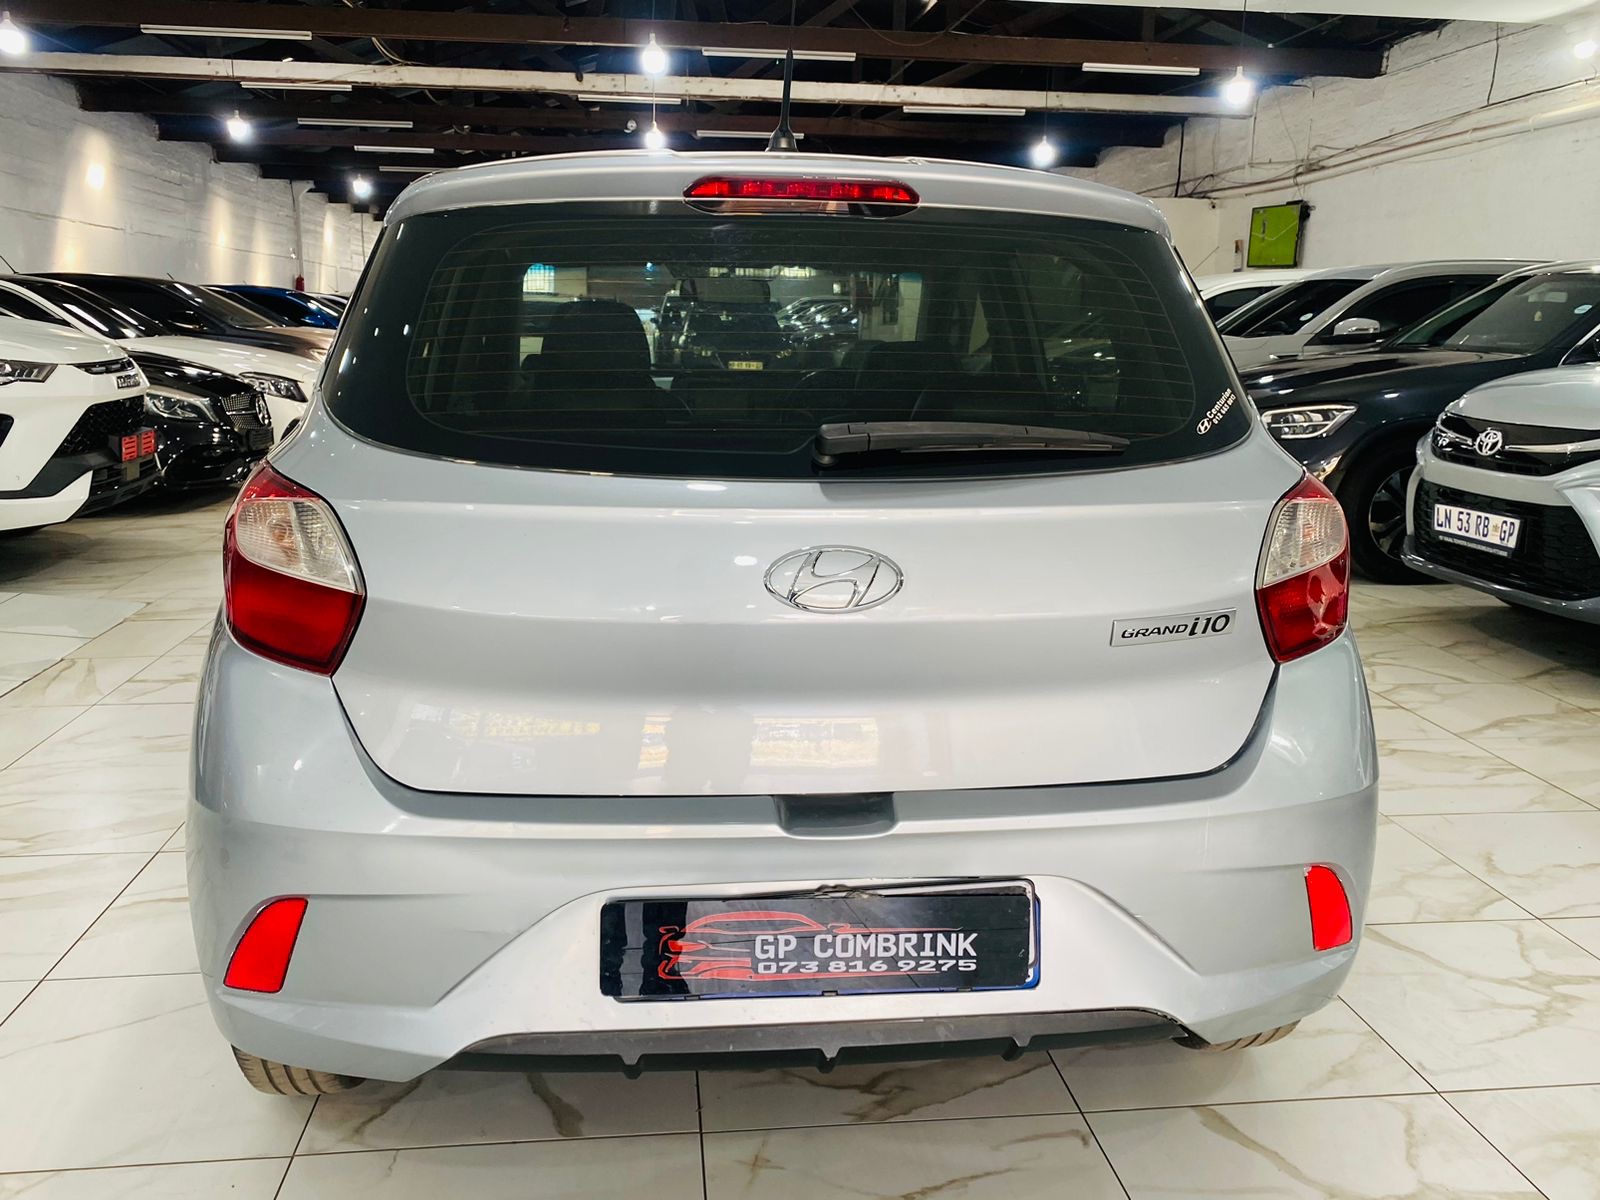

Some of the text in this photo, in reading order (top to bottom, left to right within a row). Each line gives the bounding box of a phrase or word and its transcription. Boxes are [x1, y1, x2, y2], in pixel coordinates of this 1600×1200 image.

[1436, 507, 1516, 545] LN 53 RB GP
[1121, 614, 1230, 639] GRAND i10
[754, 933, 978, 960] GP COMBRINK
[757, 958, 977, 974] 073 816 9275
